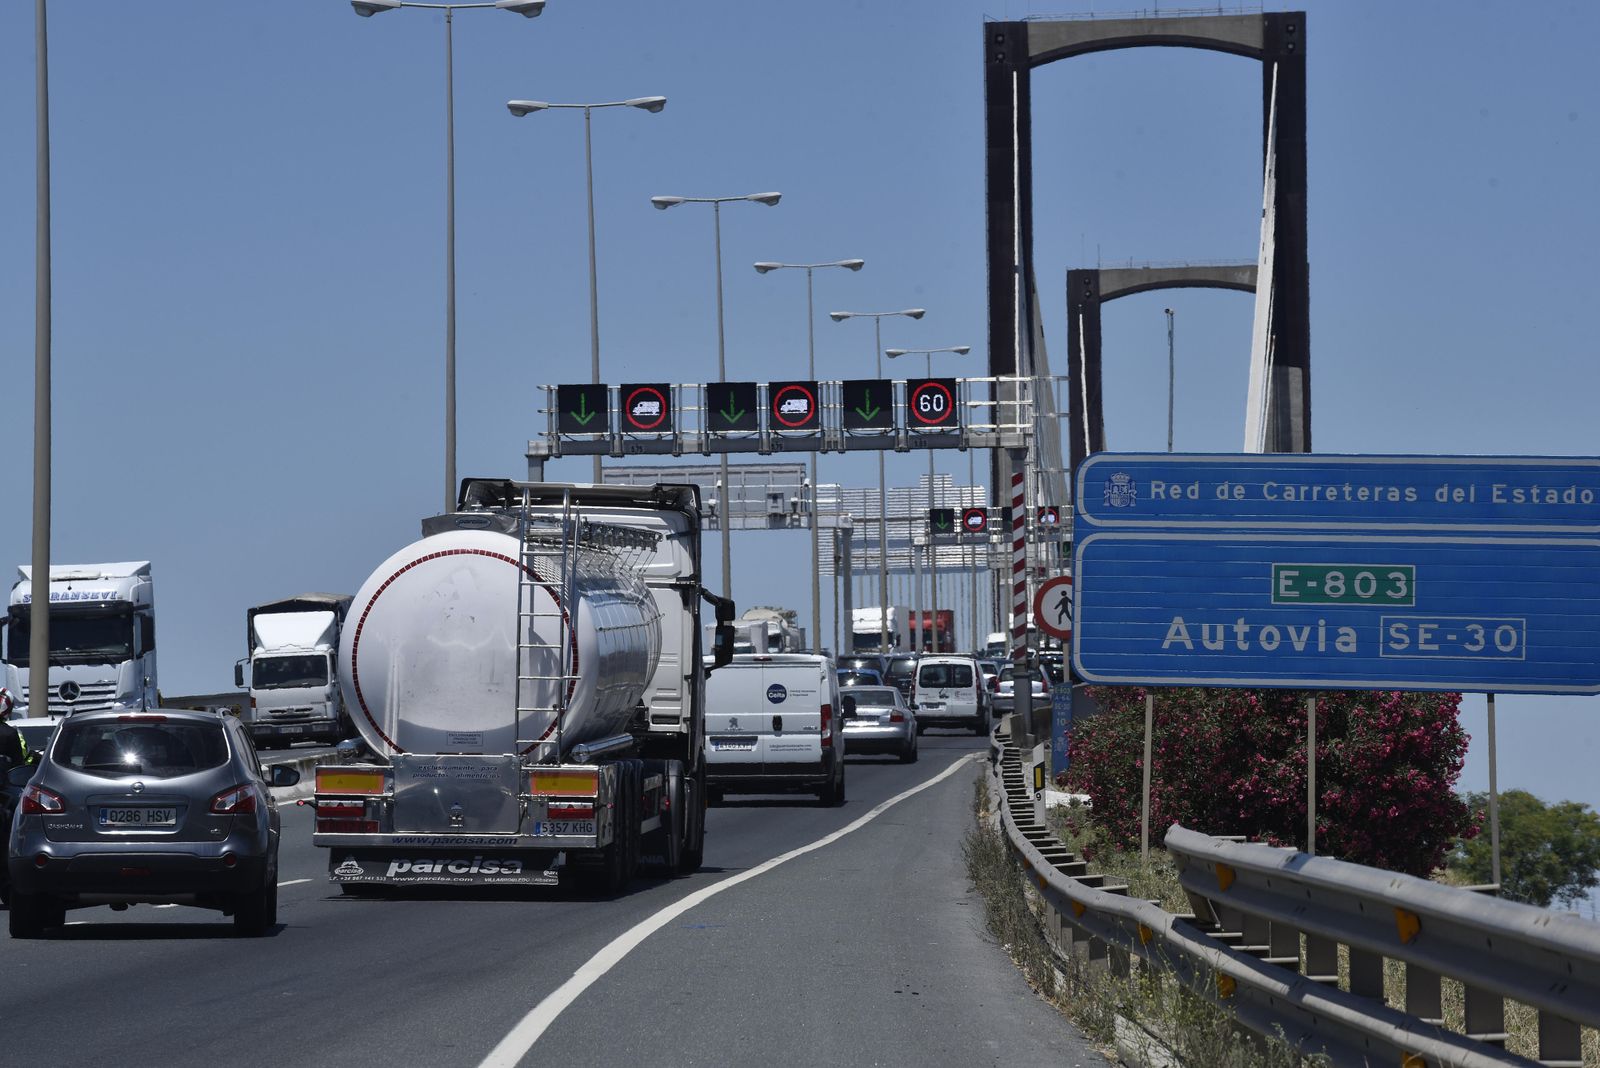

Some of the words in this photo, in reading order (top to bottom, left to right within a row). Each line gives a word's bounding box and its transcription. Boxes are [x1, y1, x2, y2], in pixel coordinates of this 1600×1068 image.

[919, 394, 944, 412] 60
[1151, 480, 1200, 499] Red
[1216, 481, 1246, 500] de
[1262, 481, 1419, 502] Carreteras
[1435, 483, 1476, 503] del
[1491, 483, 1594, 505] Estado
[1278, 570, 1409, 599] E-803
[1163, 616, 1358, 653] Autovia
[1388, 623, 1519, 653] SE-30
[1035, 792, 1042, 802] 9
[110, 810, 141, 823] 0286
[146, 810, 172, 822] HSV
[541, 822, 569, 833] 5357
[572, 823, 593, 833] KHG
[391, 835, 519, 846] www.parcisa.com
[385, 855, 523, 877] parcisa
